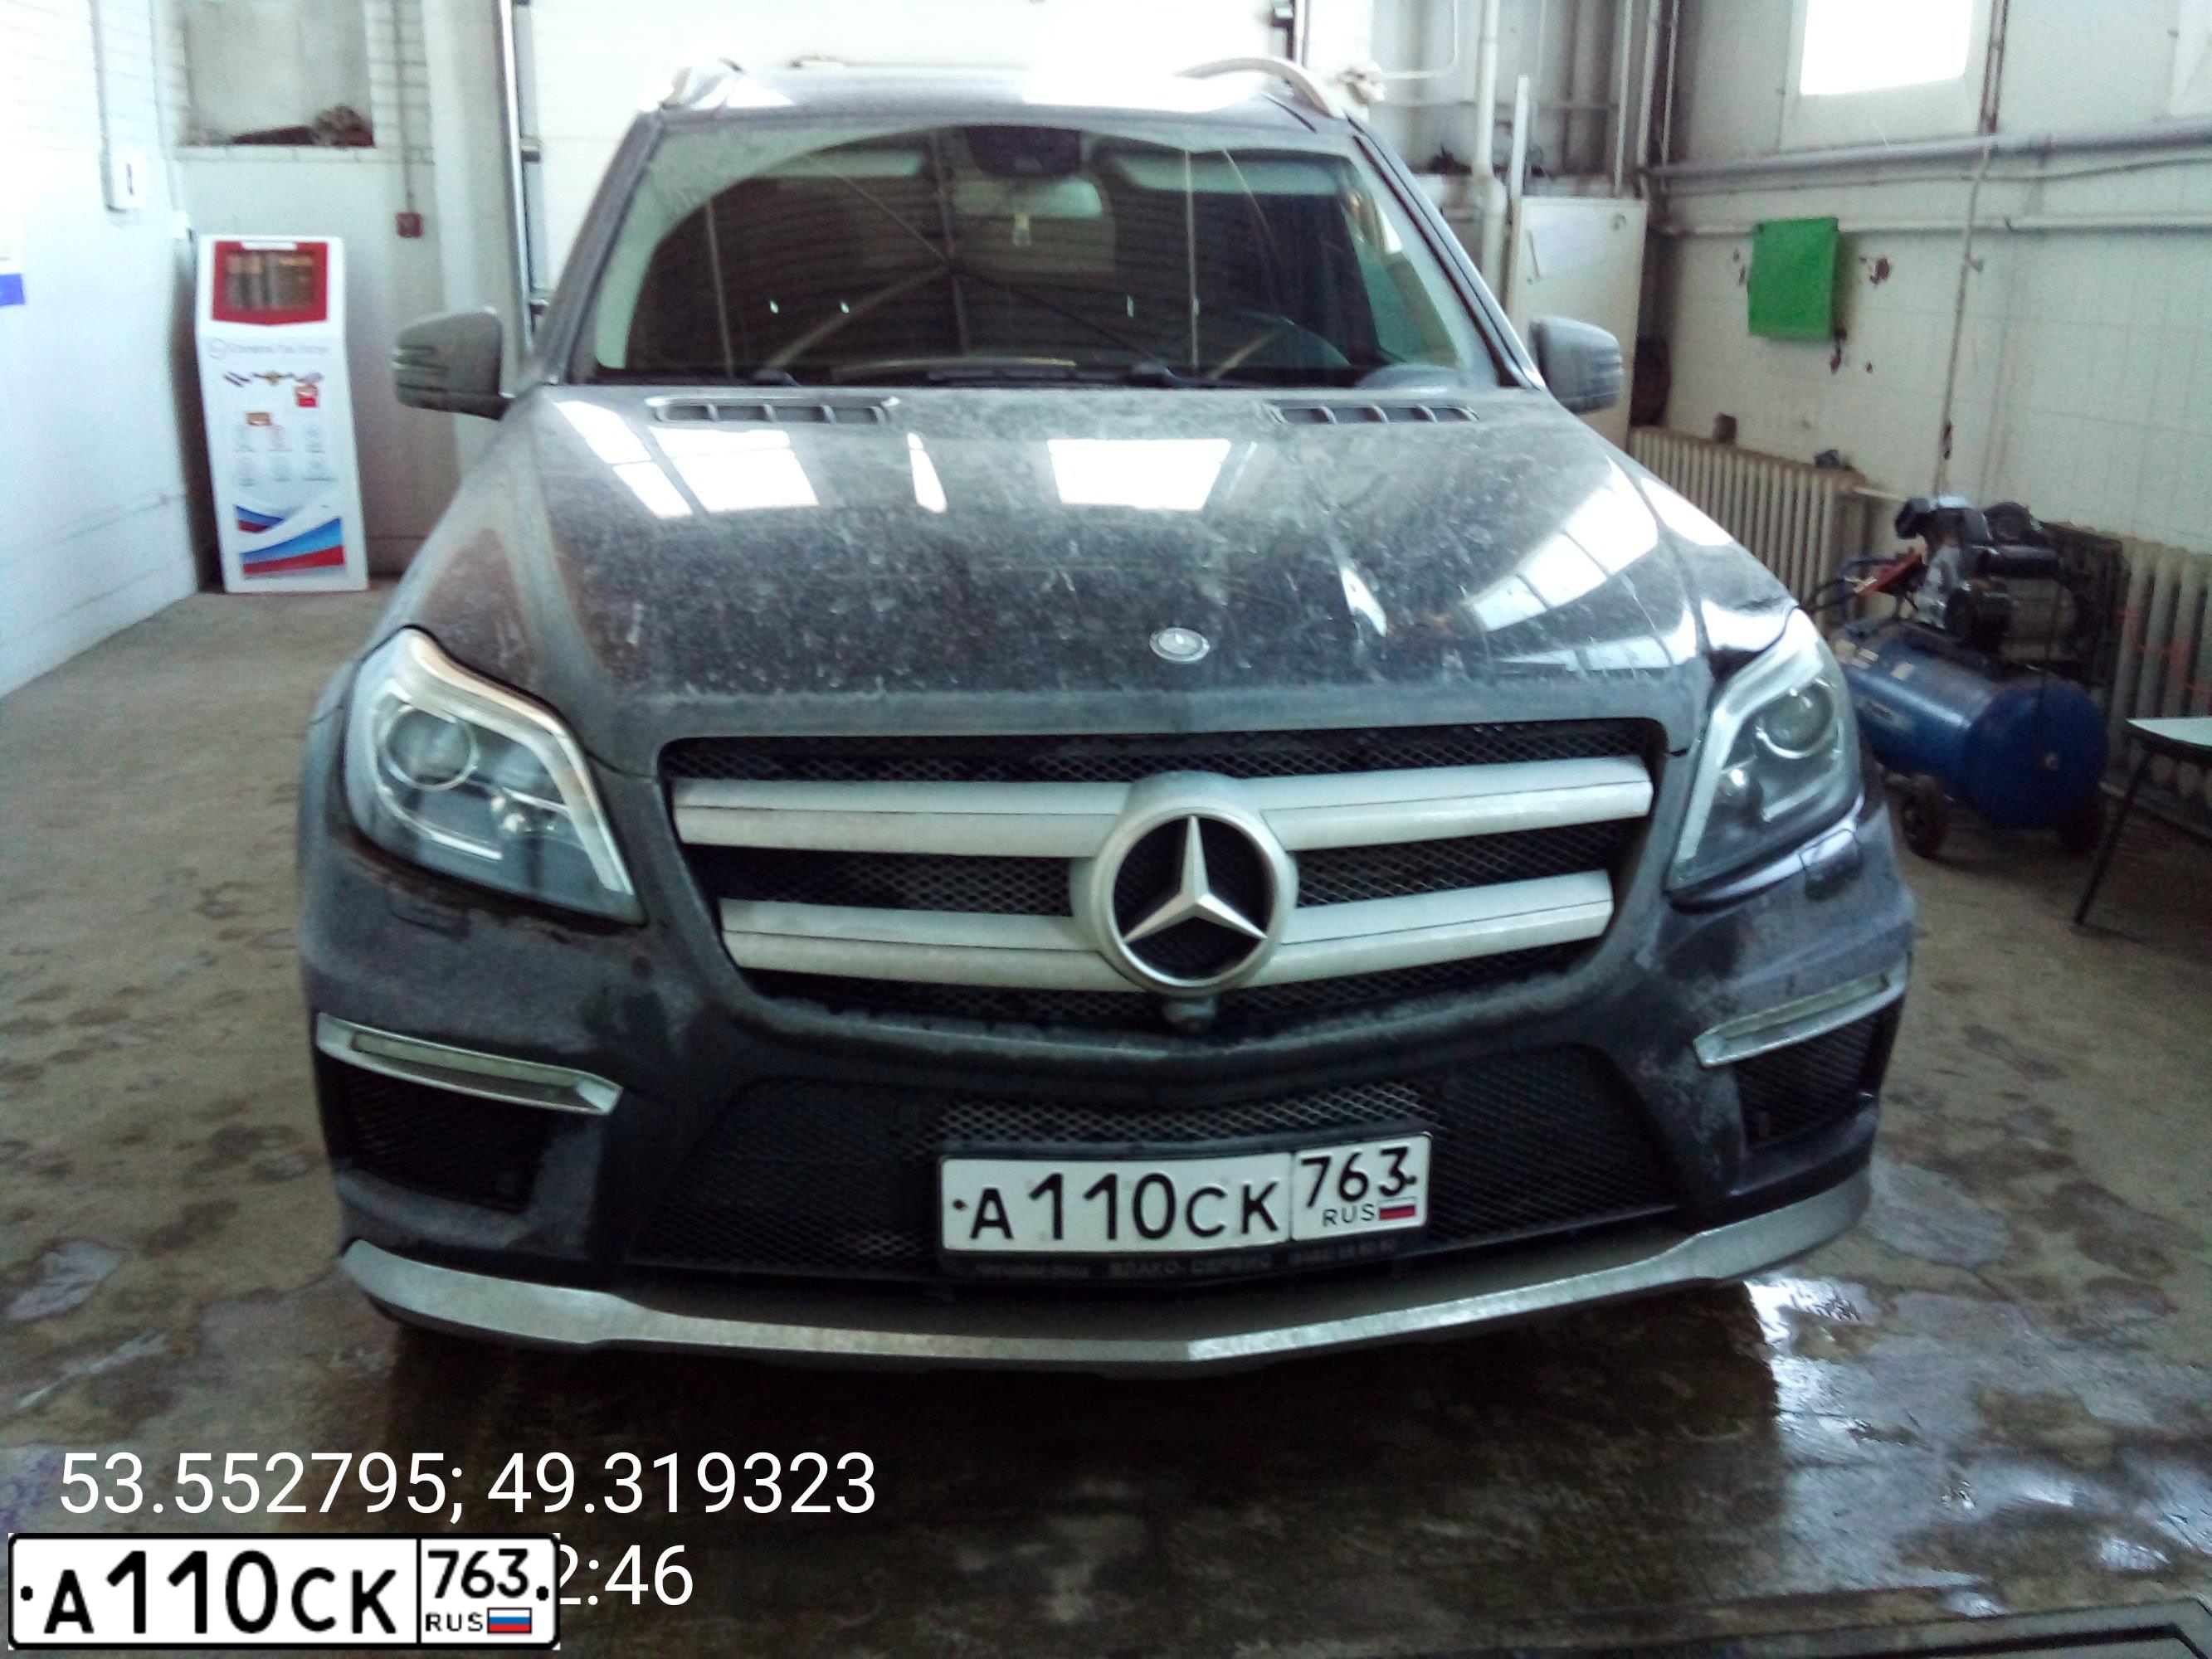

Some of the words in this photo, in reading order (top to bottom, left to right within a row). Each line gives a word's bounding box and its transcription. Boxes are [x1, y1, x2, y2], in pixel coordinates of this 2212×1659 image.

[970, 1172, 1280, 1241] А110СК
[1300, 1146, 1410, 1208] 763
[1322, 1203, 1376, 1227] RUS
